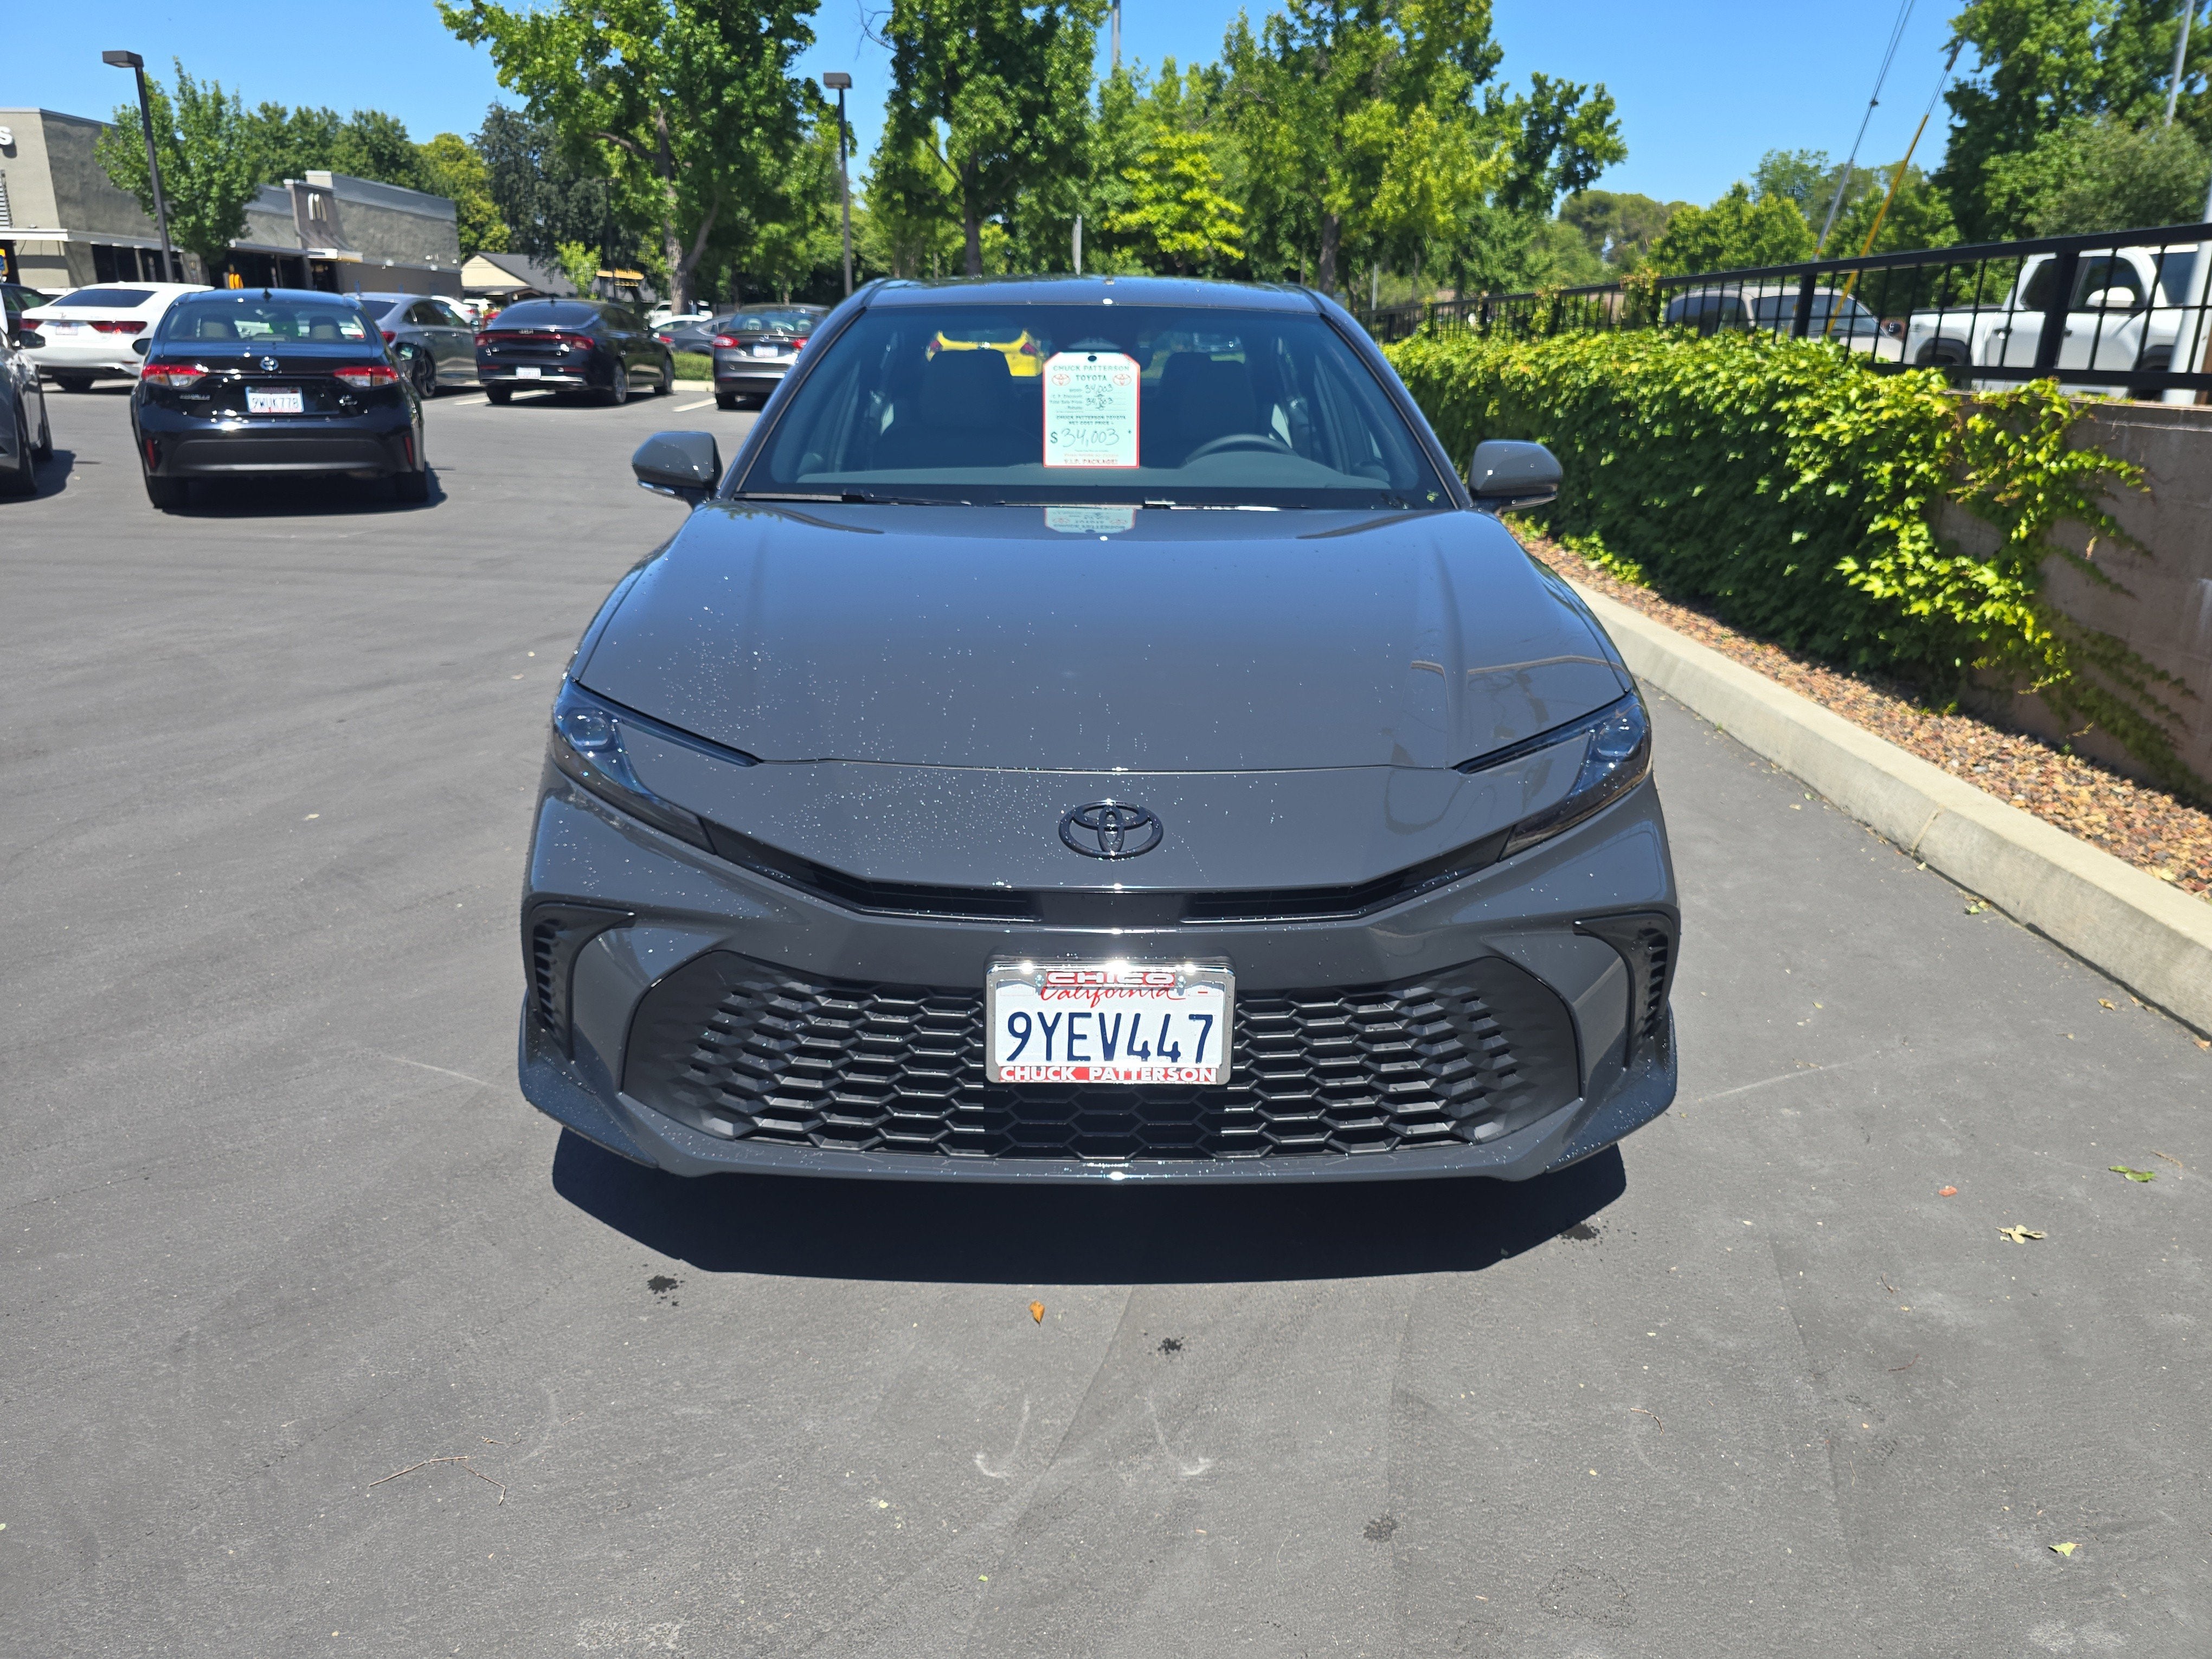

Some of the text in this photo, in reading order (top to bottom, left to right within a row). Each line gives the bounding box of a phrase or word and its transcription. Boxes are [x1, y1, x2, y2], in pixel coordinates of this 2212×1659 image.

[1050, 428, 1120, 447] $ 34,003
[1048, 972, 1175, 985] CHICO
[1040, 985, 1186, 1008] California
[1006, 1011, 1214, 1064] 9YEV447
[1000, 1066, 1217, 1083] CHUCK PATTERSON
